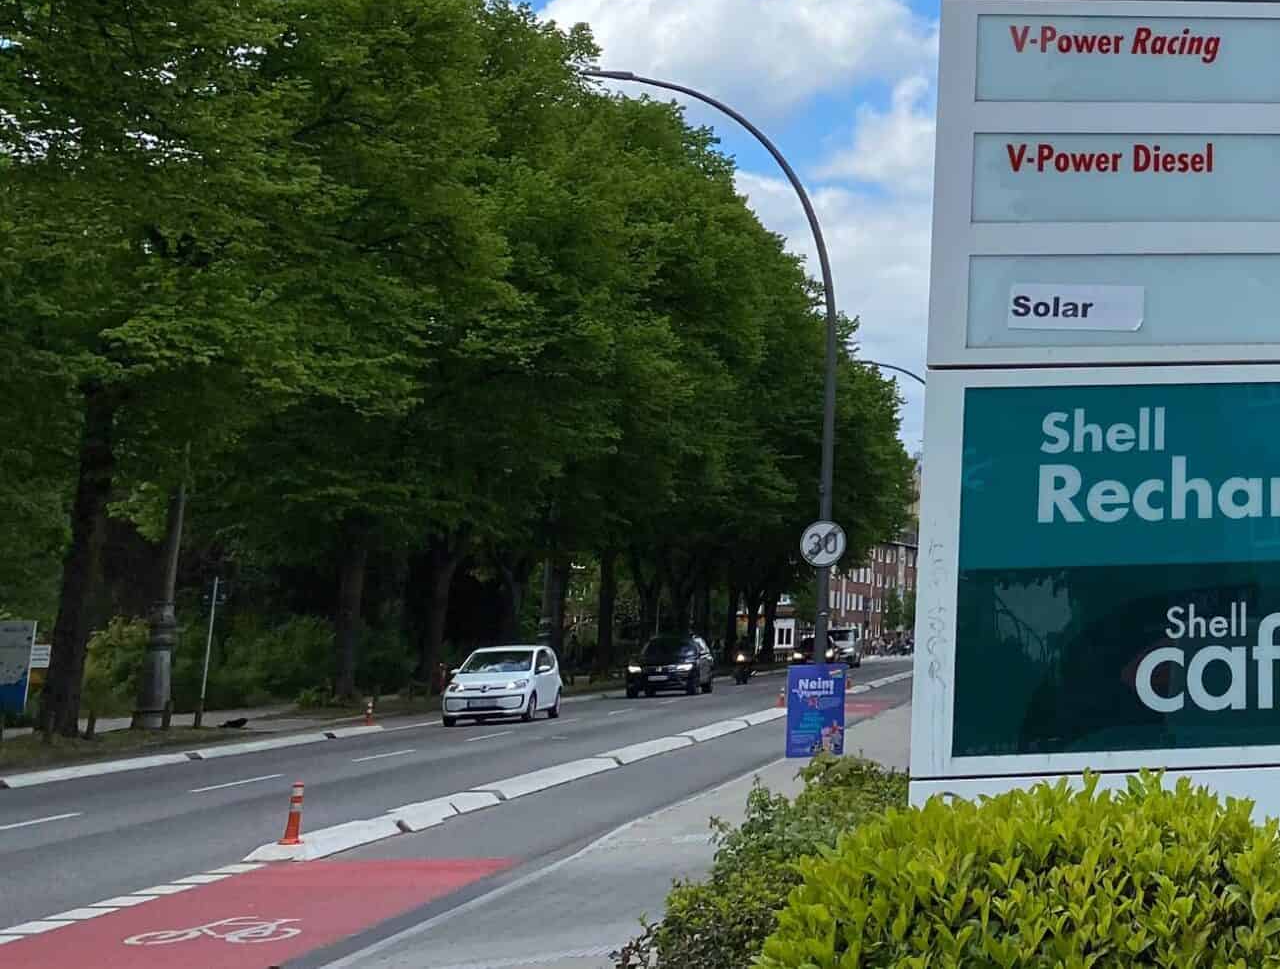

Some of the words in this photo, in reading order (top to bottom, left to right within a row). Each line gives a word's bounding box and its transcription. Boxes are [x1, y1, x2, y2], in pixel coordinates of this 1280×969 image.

[1009, 25, 1122, 55] V-Power
[1131, 28, 1221, 64] Racing
[1007, 144, 1122, 173] V-Power
[1132, 143, 1213, 173] Diesel
[1012, 294, 1093, 319] Solar
[1040, 407, 1165, 454] Shell
[808, 533, 837, 555] 30
[1165, 603, 1246, 639] Shell
